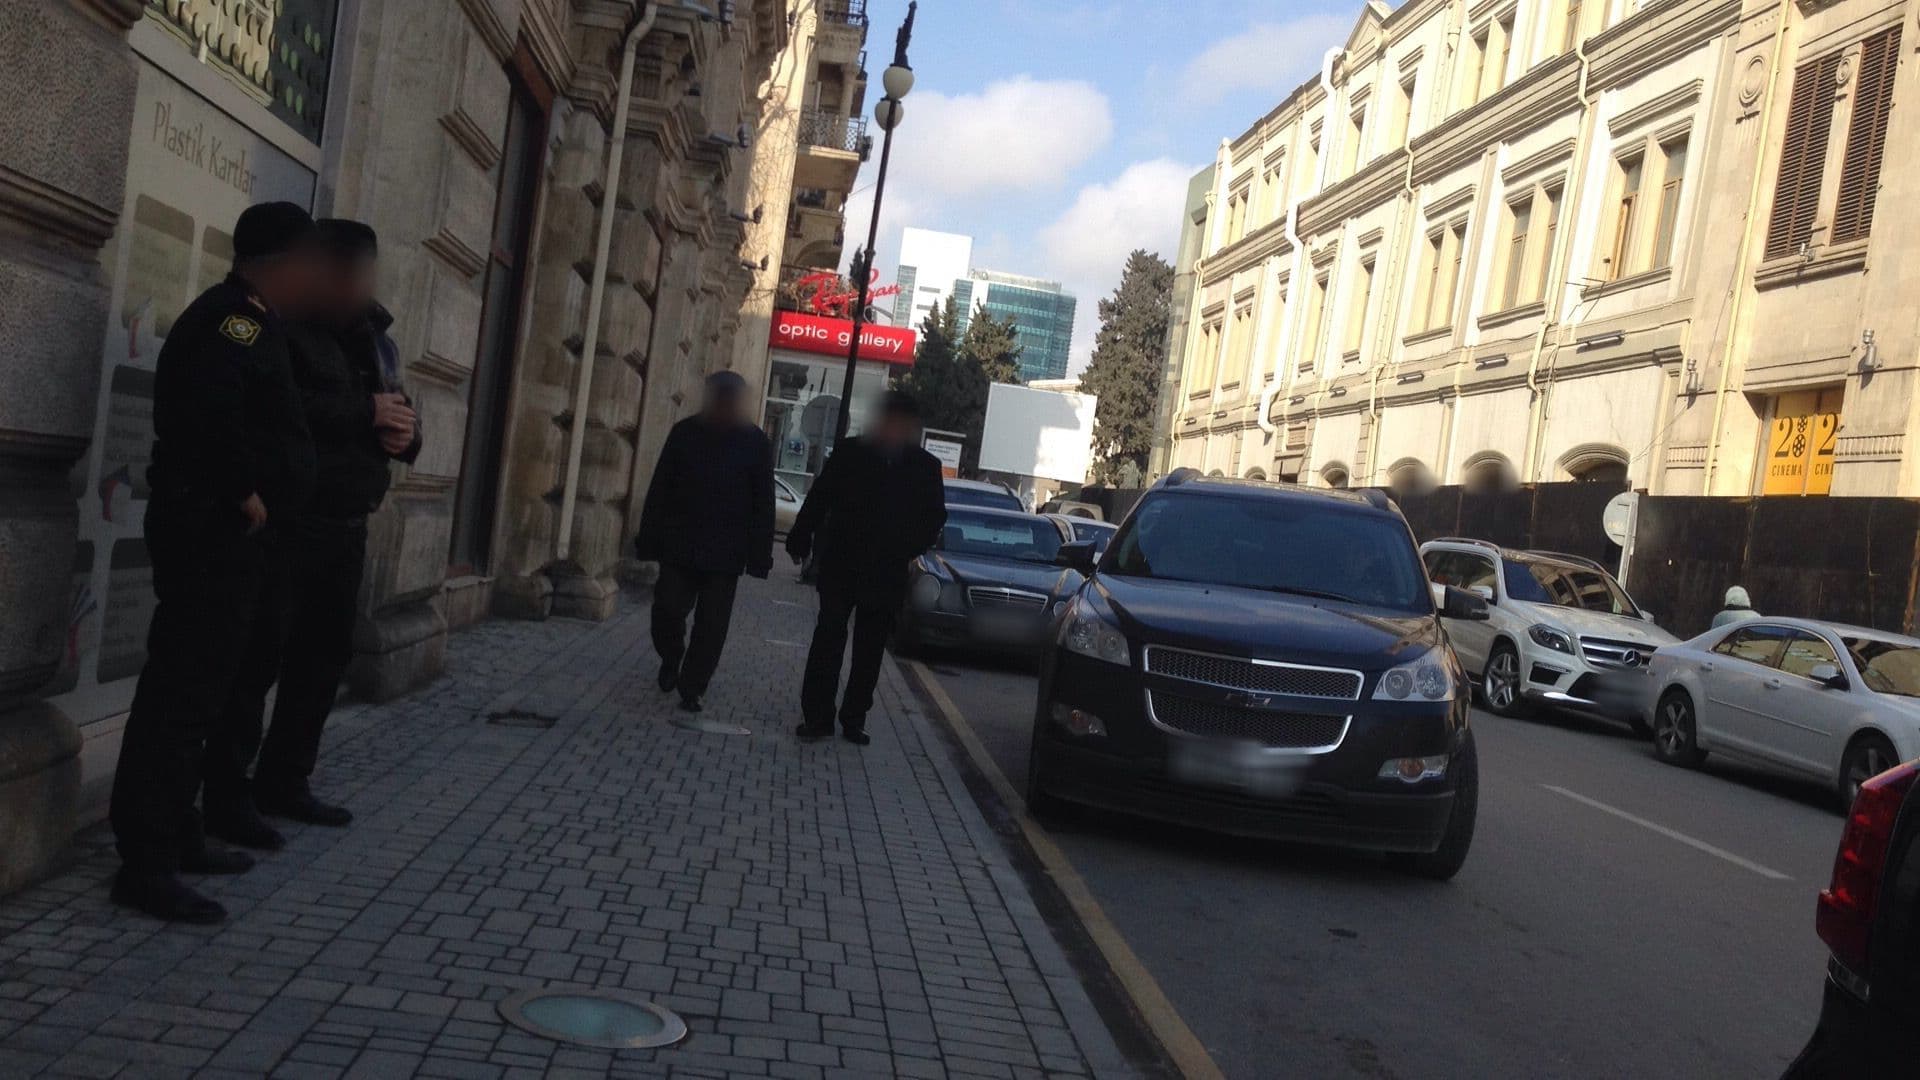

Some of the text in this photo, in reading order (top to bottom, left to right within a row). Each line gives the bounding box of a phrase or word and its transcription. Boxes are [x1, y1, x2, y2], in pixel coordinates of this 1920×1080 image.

[153, 101, 257, 196] Plastik Kartlar
[779, 323, 903, 354] optic gllery
[1771, 464, 1802, 476] CINEMA
